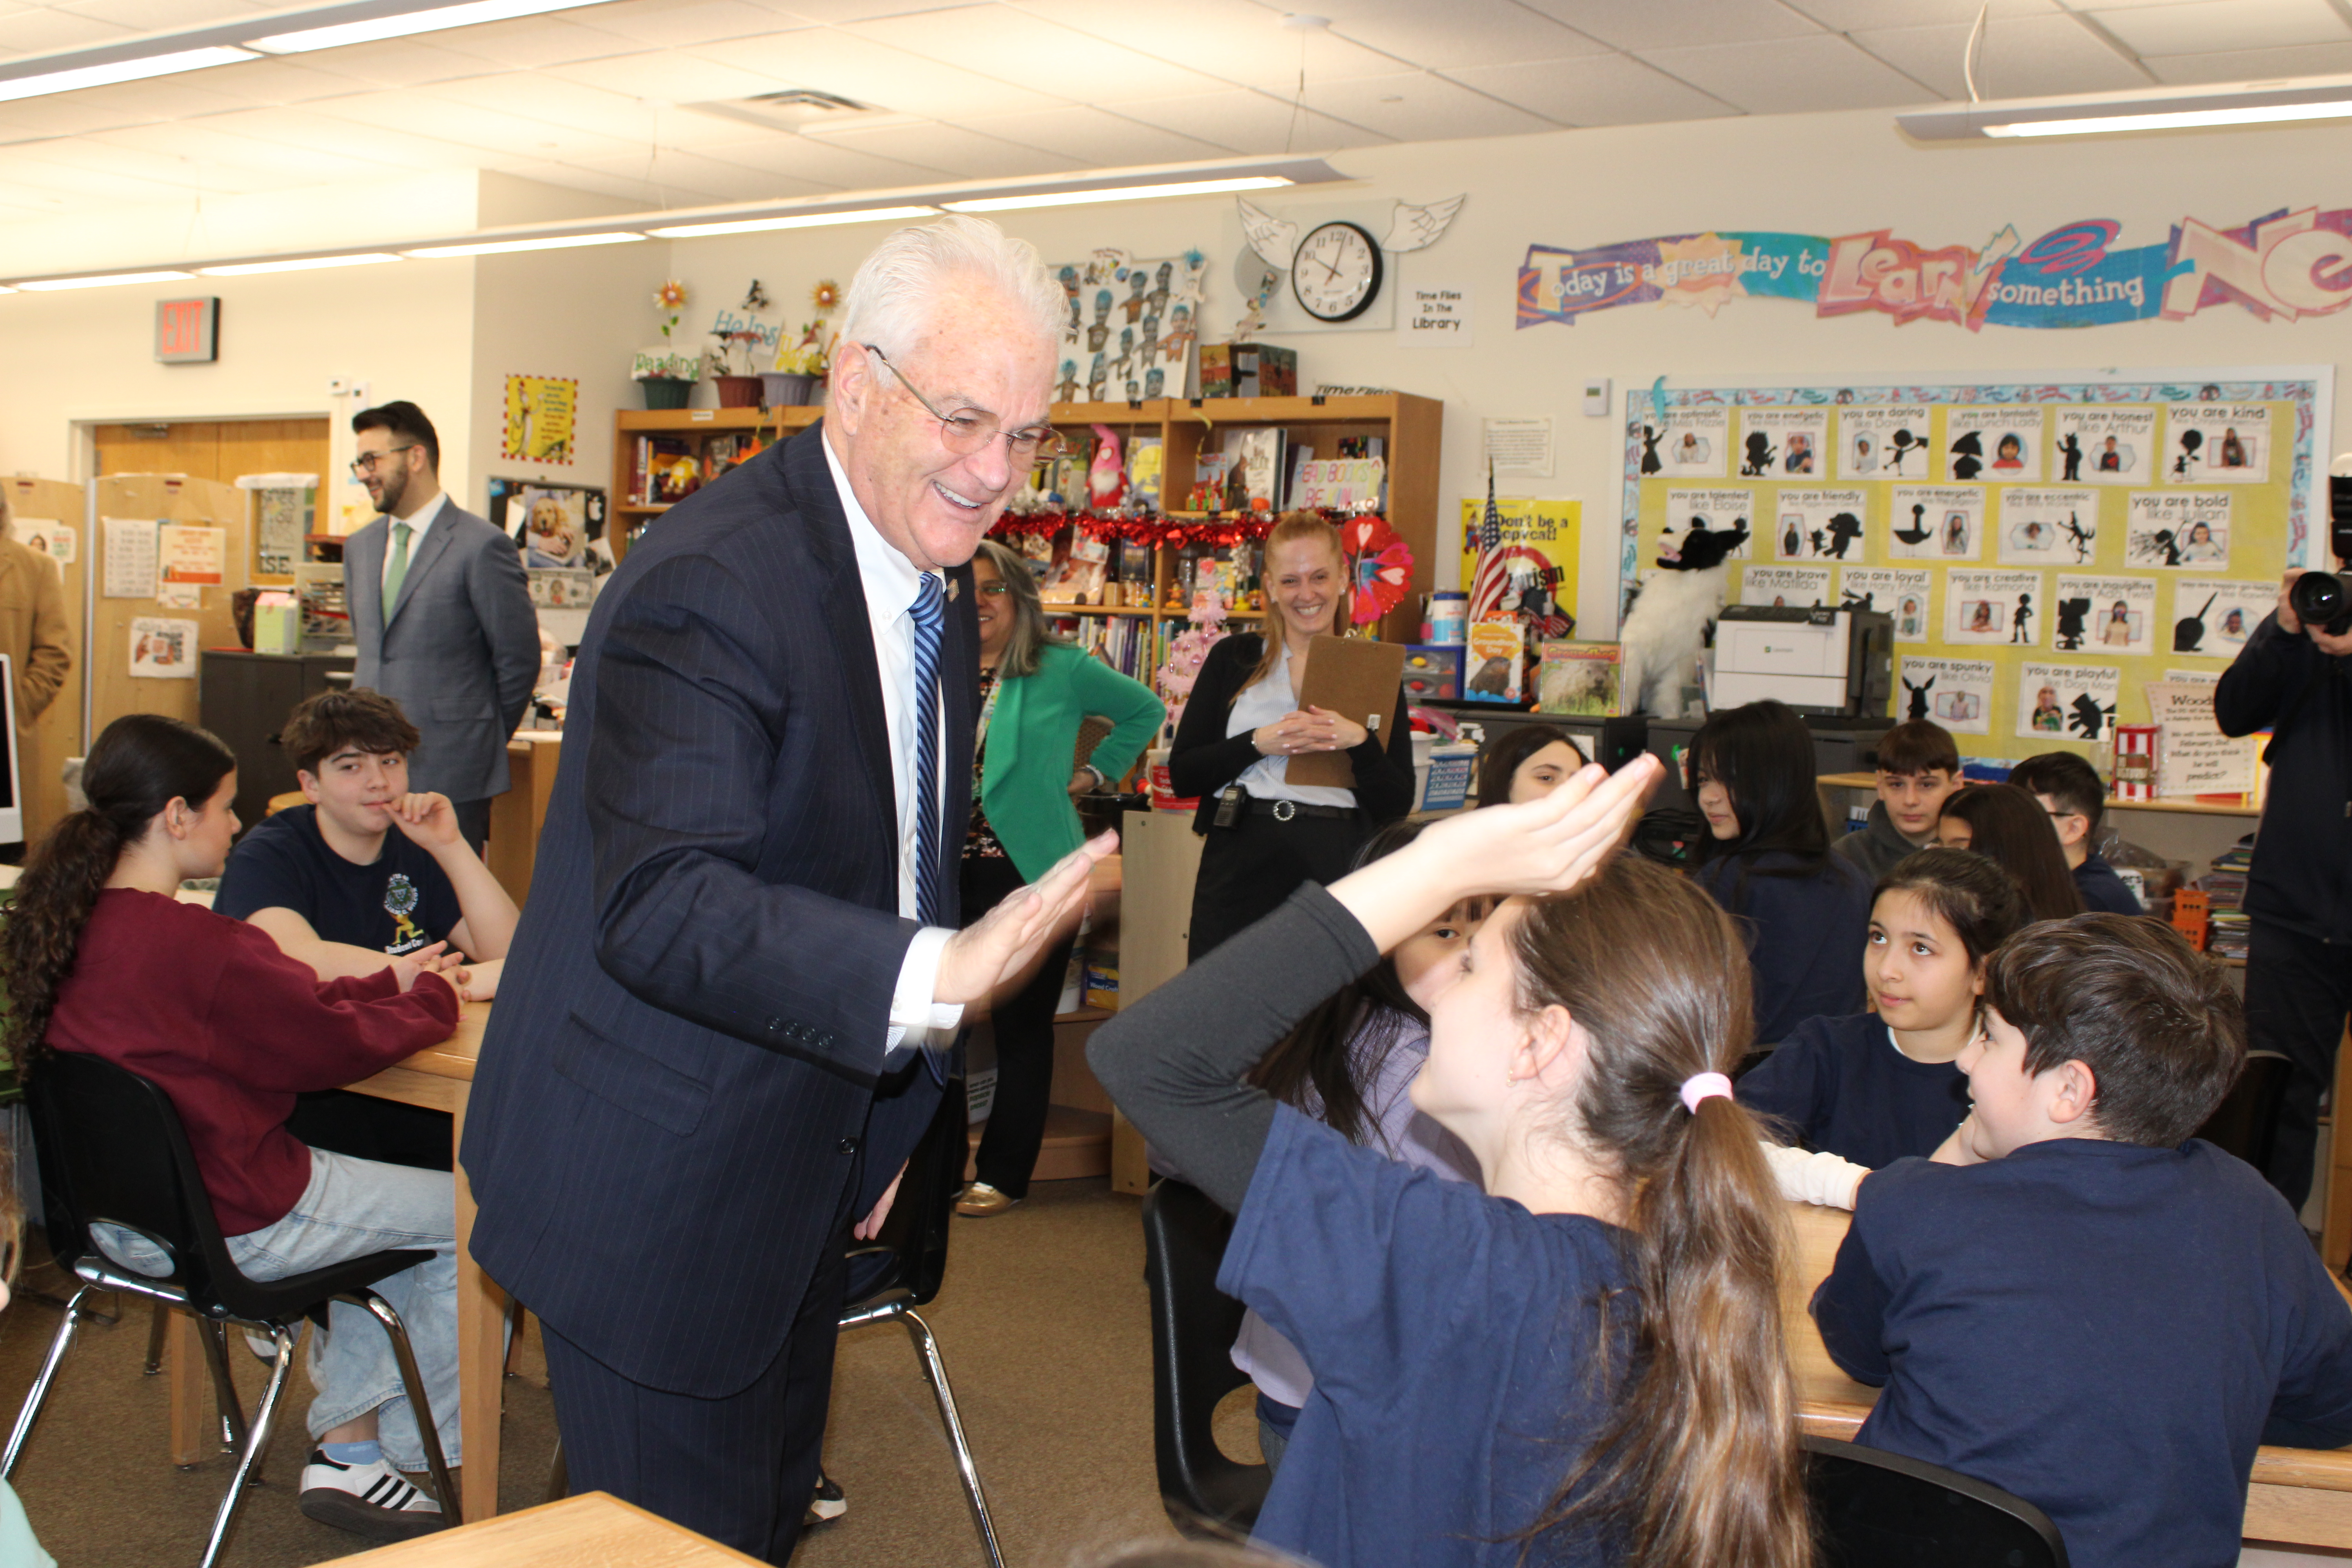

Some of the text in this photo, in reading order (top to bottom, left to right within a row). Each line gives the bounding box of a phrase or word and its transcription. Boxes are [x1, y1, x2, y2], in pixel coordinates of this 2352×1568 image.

[1529, 251, 1609, 313] Today
[1615, 260, 1635, 284] is
[1641, 265, 1658, 281] a
[1663, 249, 1735, 285] great
[1741, 246, 1790, 279] day
[1798, 248, 1827, 277] to
[1986, 274, 2145, 307] something
[1416, 290, 1462, 300] Time Flies
[1423, 303, 1453, 313] In The
[163, 300, 204, 354] EXIT
[713, 310, 780, 352] Helps
[1412, 317, 1461, 332] Library
[1843, 407, 1925, 420] you are daring
[2063, 410, 2153, 422] you are honest
[2169, 405, 2265, 419] you are kind
[1875, 418, 1909, 428] David
[2104, 421, 2148, 434] Arthur
[1295, 463, 1326, 483] READ
[1709, 490, 1750, 499] talented
[1780, 493, 1800, 502] you
[1823, 490, 1862, 503] friendly
[2132, 495, 2229, 509] you are bold
[2147, 507, 2172, 520] like
[1537, 514, 1556, 528] be
[1560, 517, 1568, 528] a
[1501, 528, 1557, 542] opycat!
[1753, 569, 1828, 580] you are brave
[1846, 571, 1927, 584] you are loyal
[1951, 575, 1971, 583] you
[1994, 573, 2038, 583] creative
[1486, 646, 1503, 655] Day
[1548, 647, 1619, 662] Groundhog
[1904, 660, 1992, 674] you are spunky
[2027, 667, 2117, 681] you are playful
[2171, 694, 2215, 706] Wood
[2179, 740, 2213, 748] February
[2185, 770, 2228, 783] predict?
[383, 941, 412, 954] Student
[1090, 981, 1105, 990] Wood
